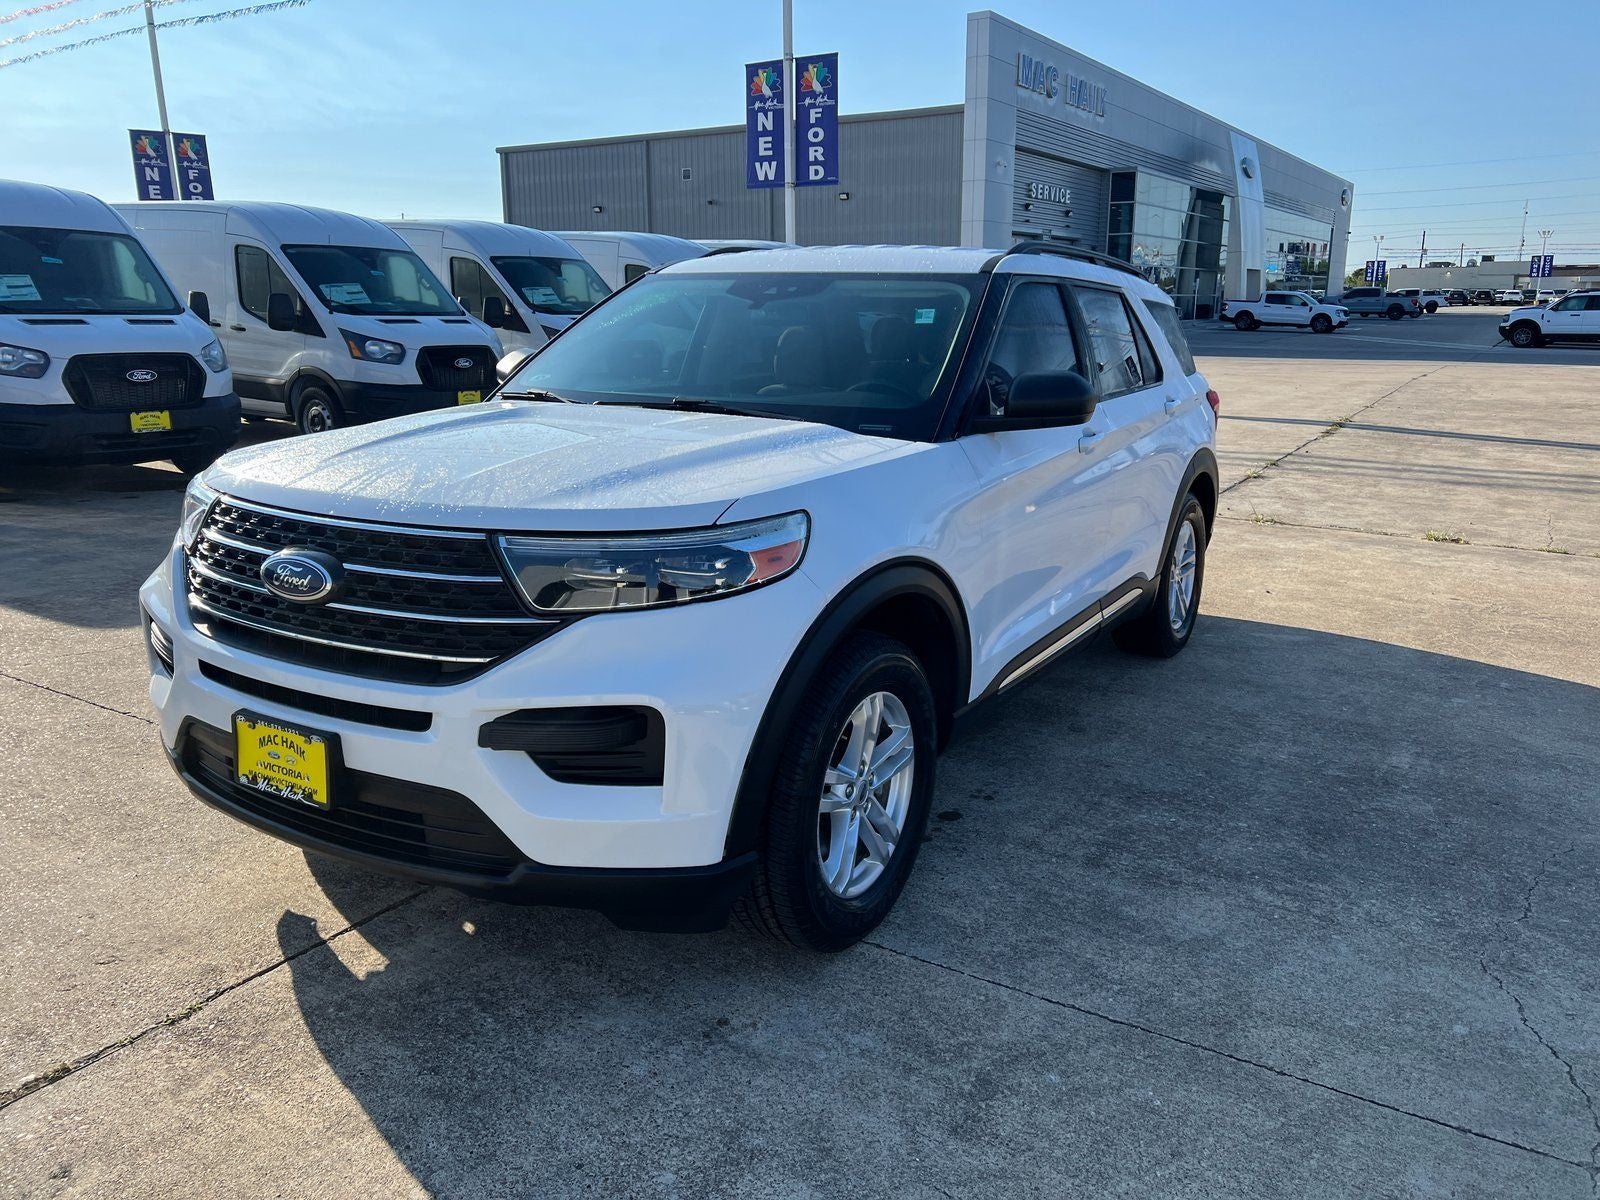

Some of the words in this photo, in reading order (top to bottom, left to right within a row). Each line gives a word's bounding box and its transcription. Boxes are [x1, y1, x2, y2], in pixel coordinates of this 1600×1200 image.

[1017, 53, 1059, 98] MAC
[755, 111, 777, 181] NEW
[807, 108, 825, 181] FORD
[144, 166, 162, 199] NE
[1030, 182, 1071, 204] SERVICE
[132, 371, 152, 380] Ford
[272, 563, 312, 590] Ford
[258, 734, 279, 749] MAC
[281, 736, 306, 761] HAIK
[263, 761, 303, 780] VICTORIA
[256, 778, 279, 795] Mac
[280, 786, 306, 801] Haik
